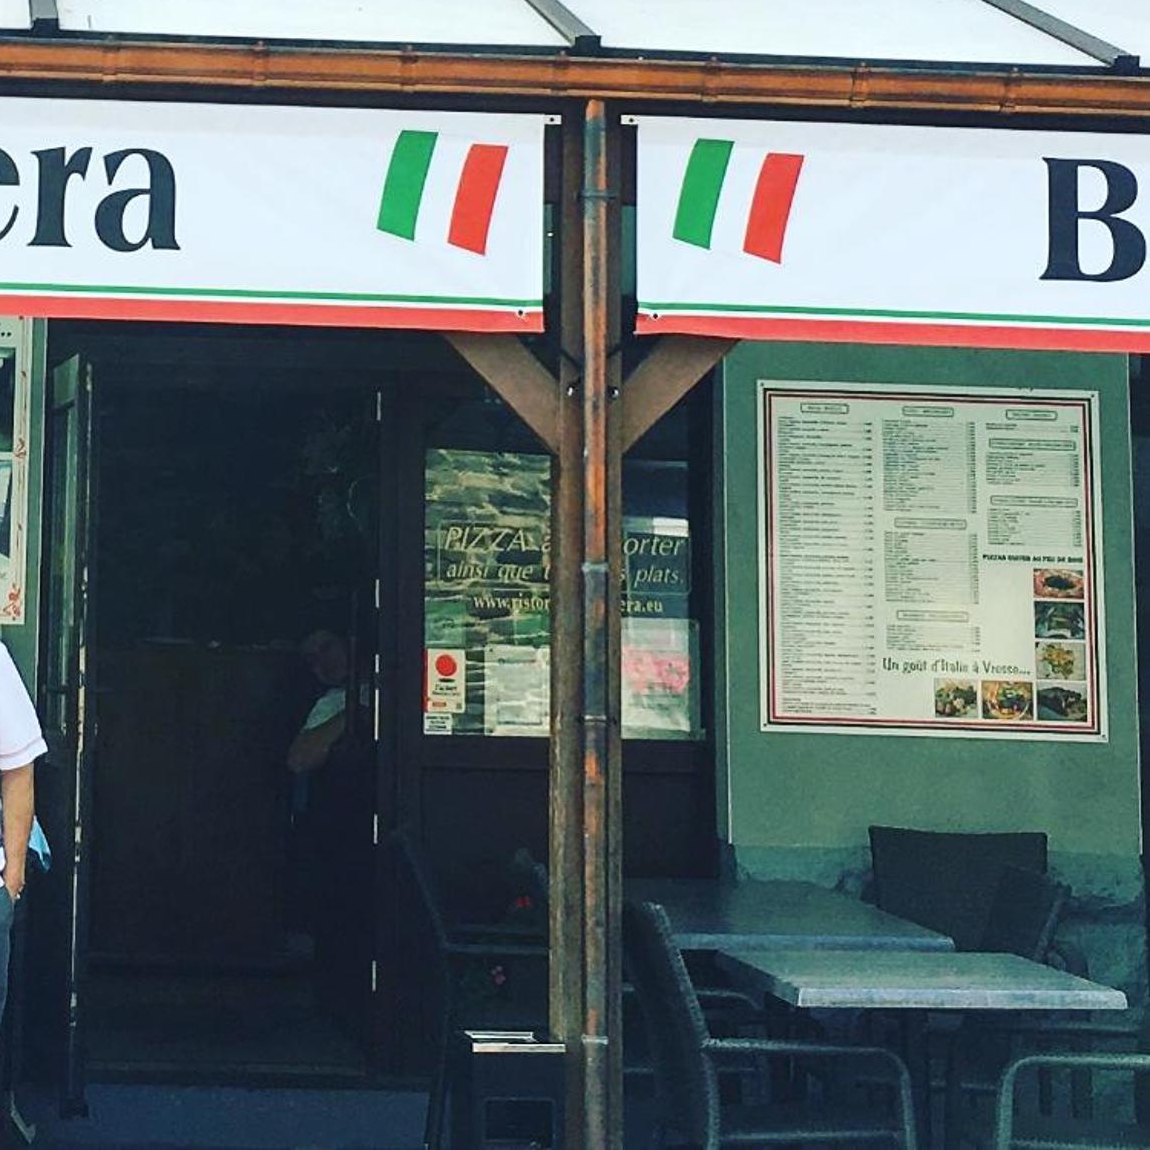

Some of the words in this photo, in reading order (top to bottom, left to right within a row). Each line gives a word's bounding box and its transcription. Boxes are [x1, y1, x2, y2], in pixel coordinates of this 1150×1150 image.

[1039, 156, 1146, 282] B
[623, 536, 684, 556] orter
[497, 563, 534, 583] que
